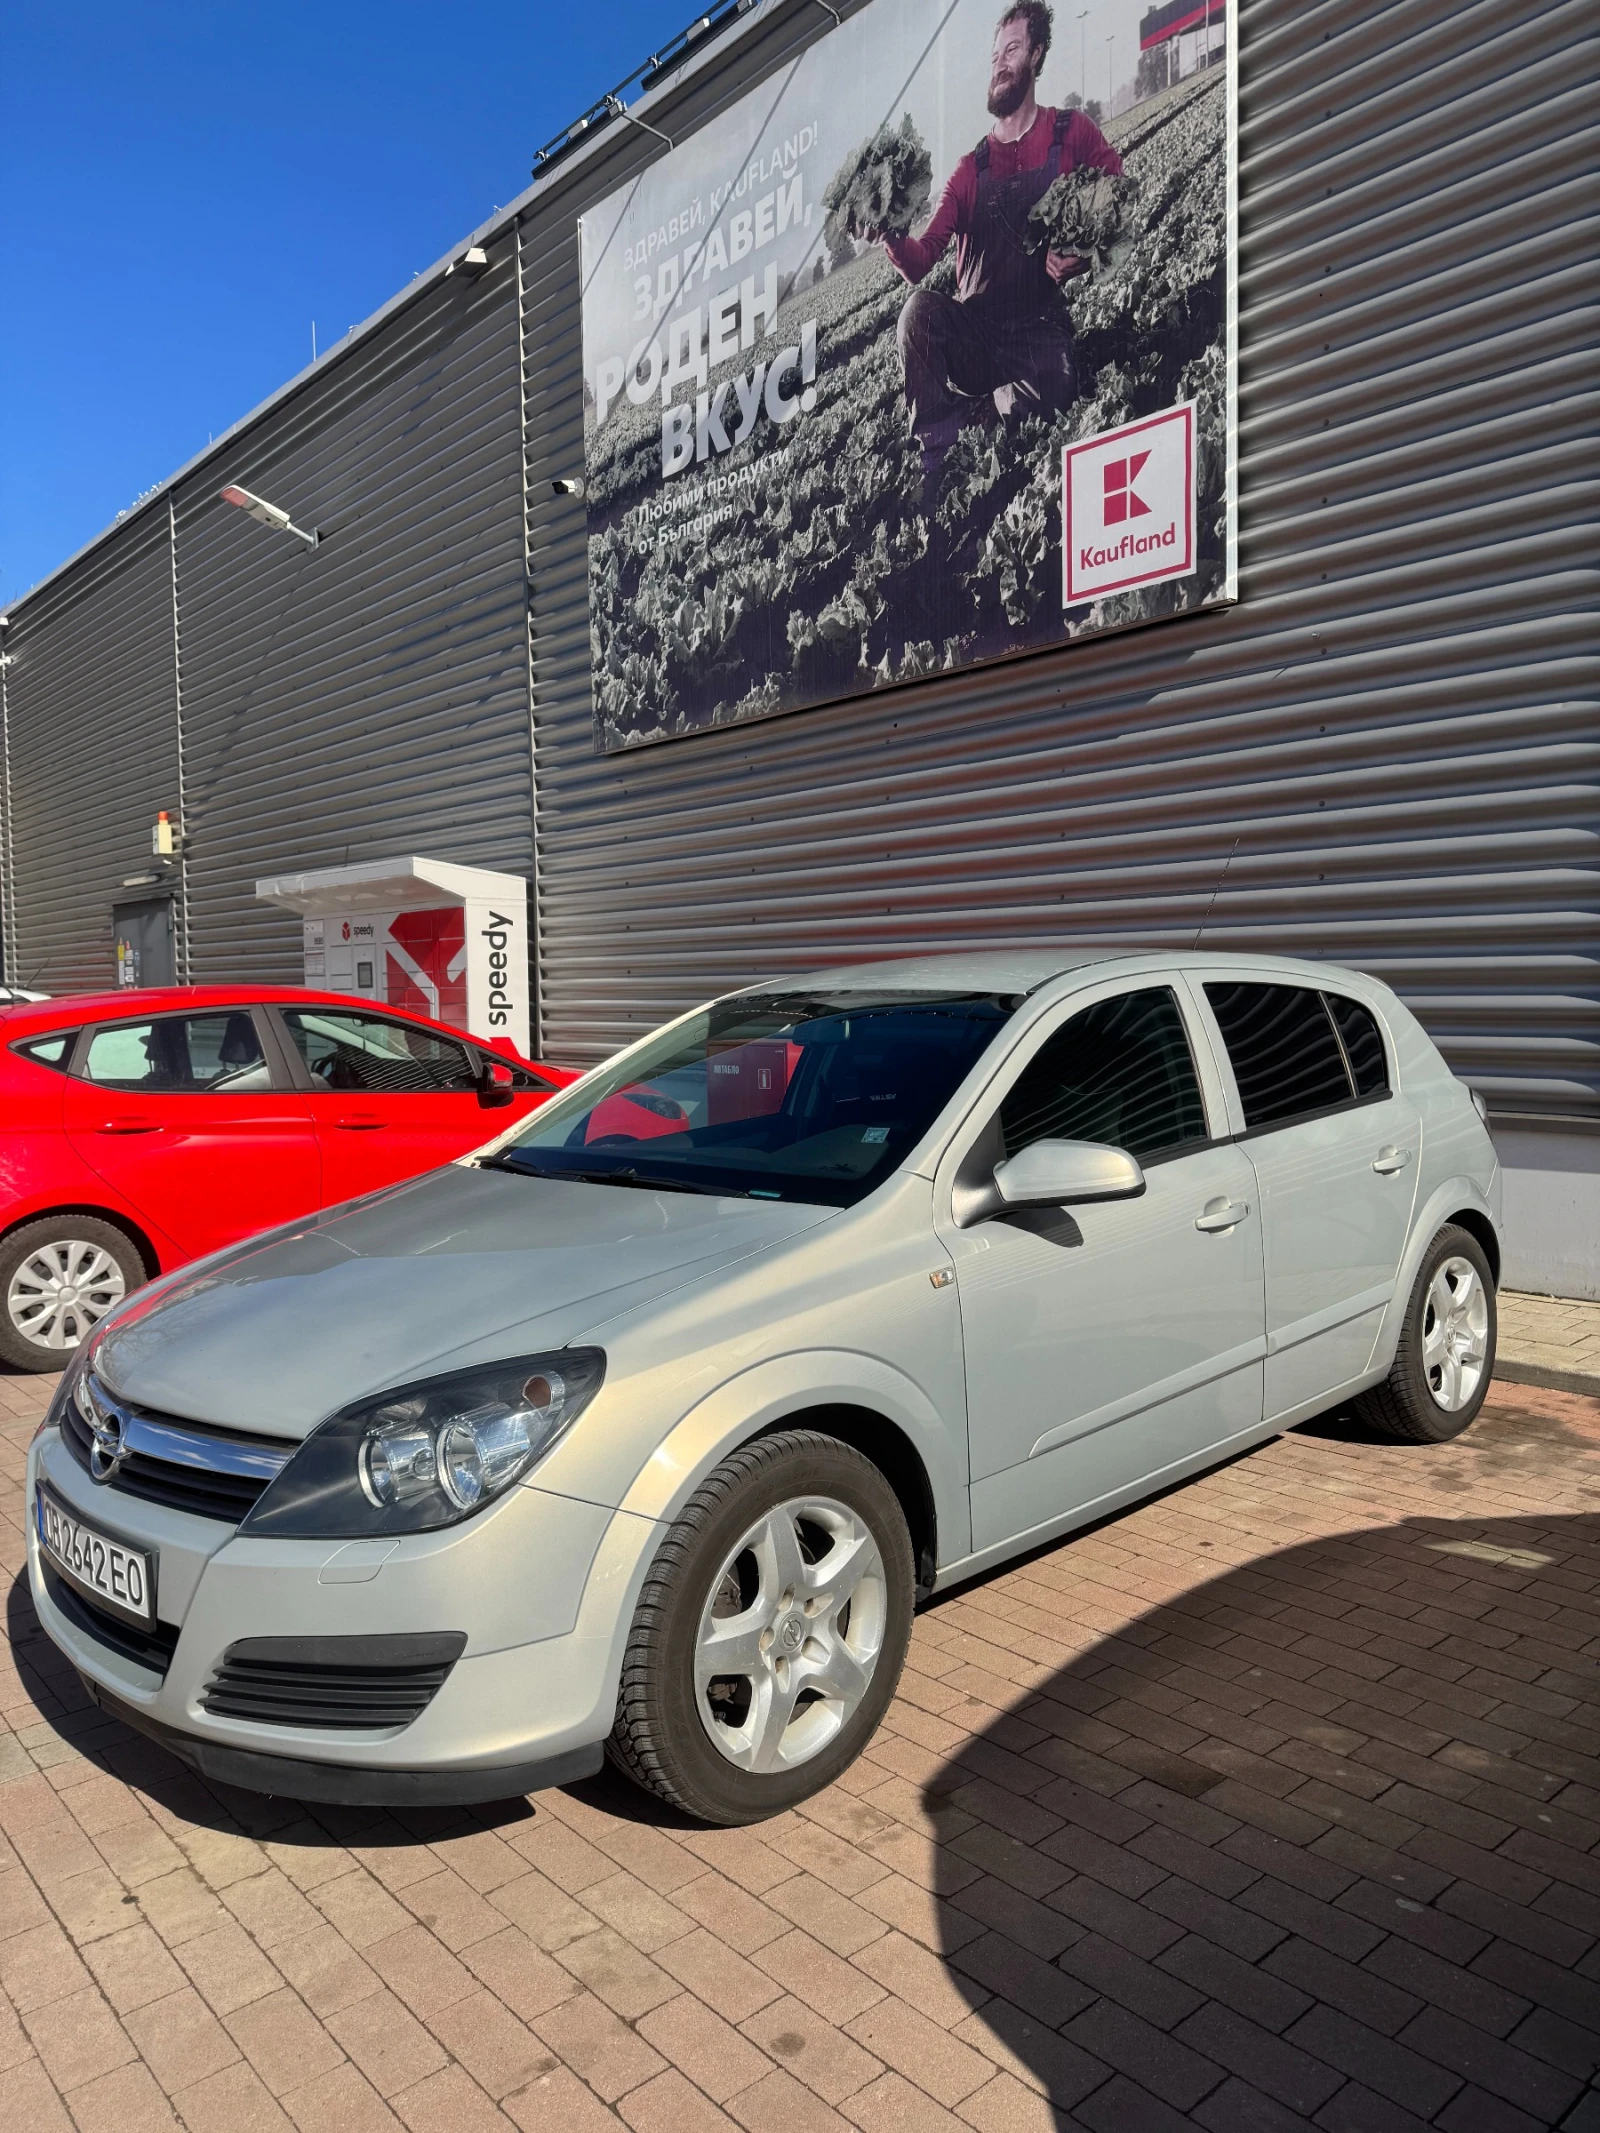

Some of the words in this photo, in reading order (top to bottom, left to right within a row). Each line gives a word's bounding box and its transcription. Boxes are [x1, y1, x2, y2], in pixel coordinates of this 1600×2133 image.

[623, 200, 707, 272] ЗДРАВЕЙ,
[710, 121, 818, 215] KAUFLAND!
[633, 160, 813, 322] ЗДРАВЕЙ,
[596, 261, 778, 426] РОДЕН
[661, 318, 817, 479] ВКУС!
[638, 486, 704, 526] Любими
[706, 447, 790, 495] продукти
[638, 536, 655, 555] от
[658, 503, 733, 546] България
[1080, 521, 1176, 570] Kaufland
[353, 923, 374, 938] speedy
[482, 910, 513, 1026] speedy
